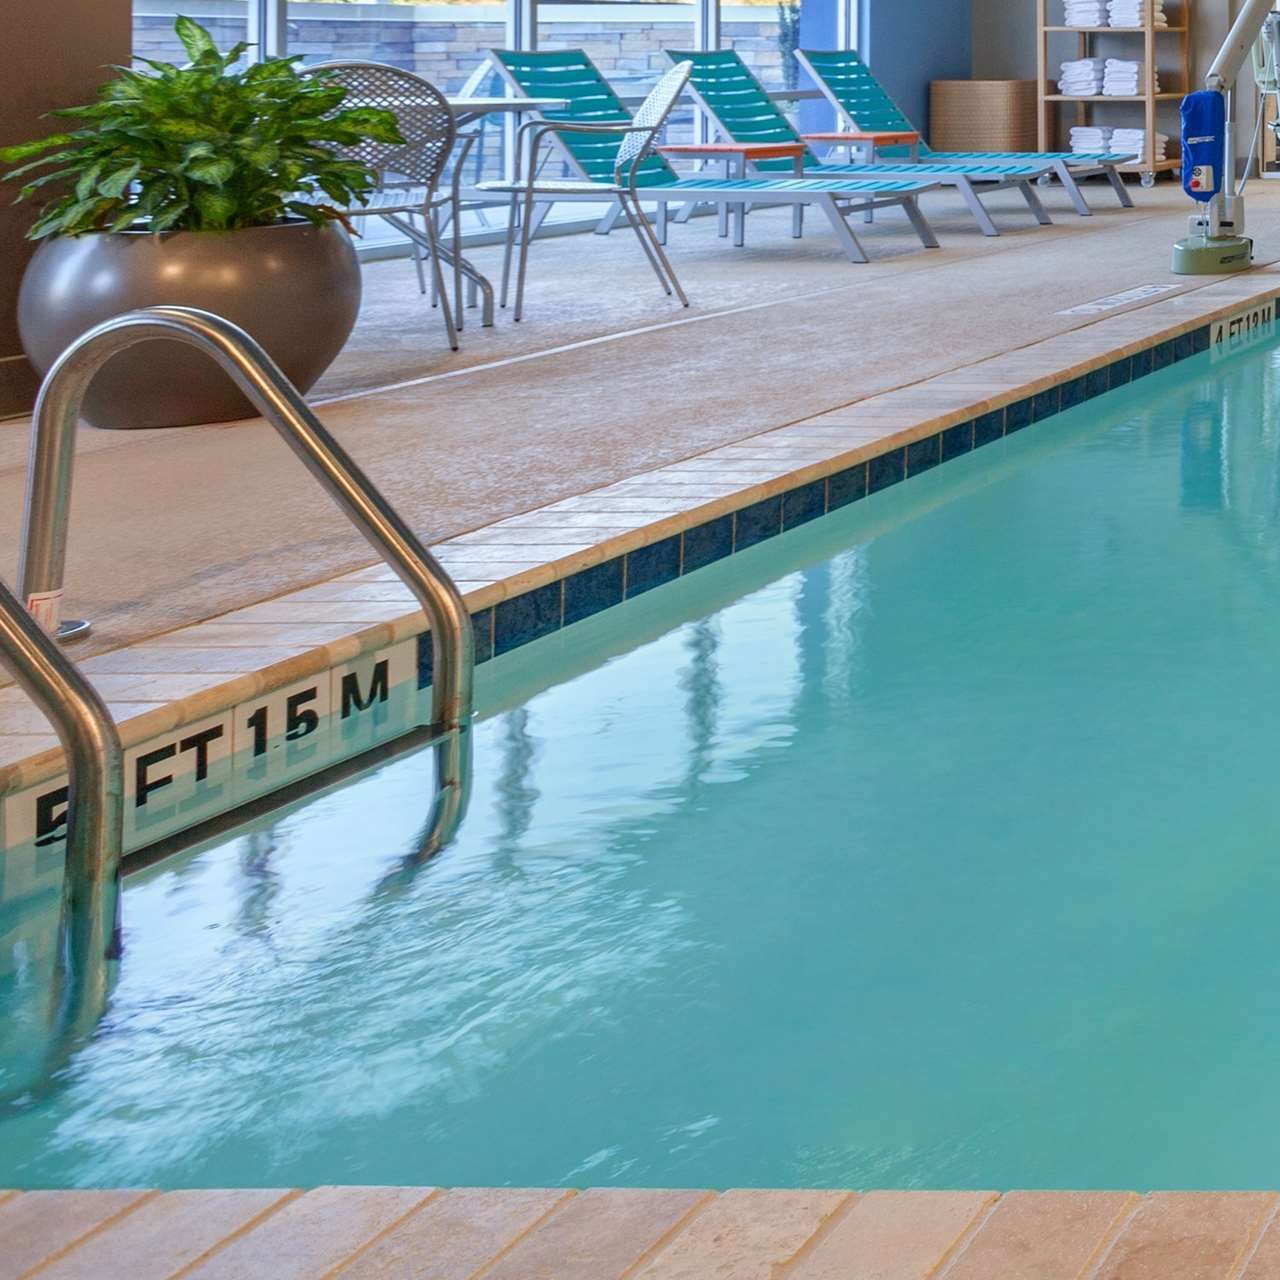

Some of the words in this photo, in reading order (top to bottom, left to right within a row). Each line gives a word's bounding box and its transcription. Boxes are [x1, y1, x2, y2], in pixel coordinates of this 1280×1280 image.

[35, 786, 69, 848] 5
[135, 724, 224, 808] FT
[341, 659, 389, 719] M
